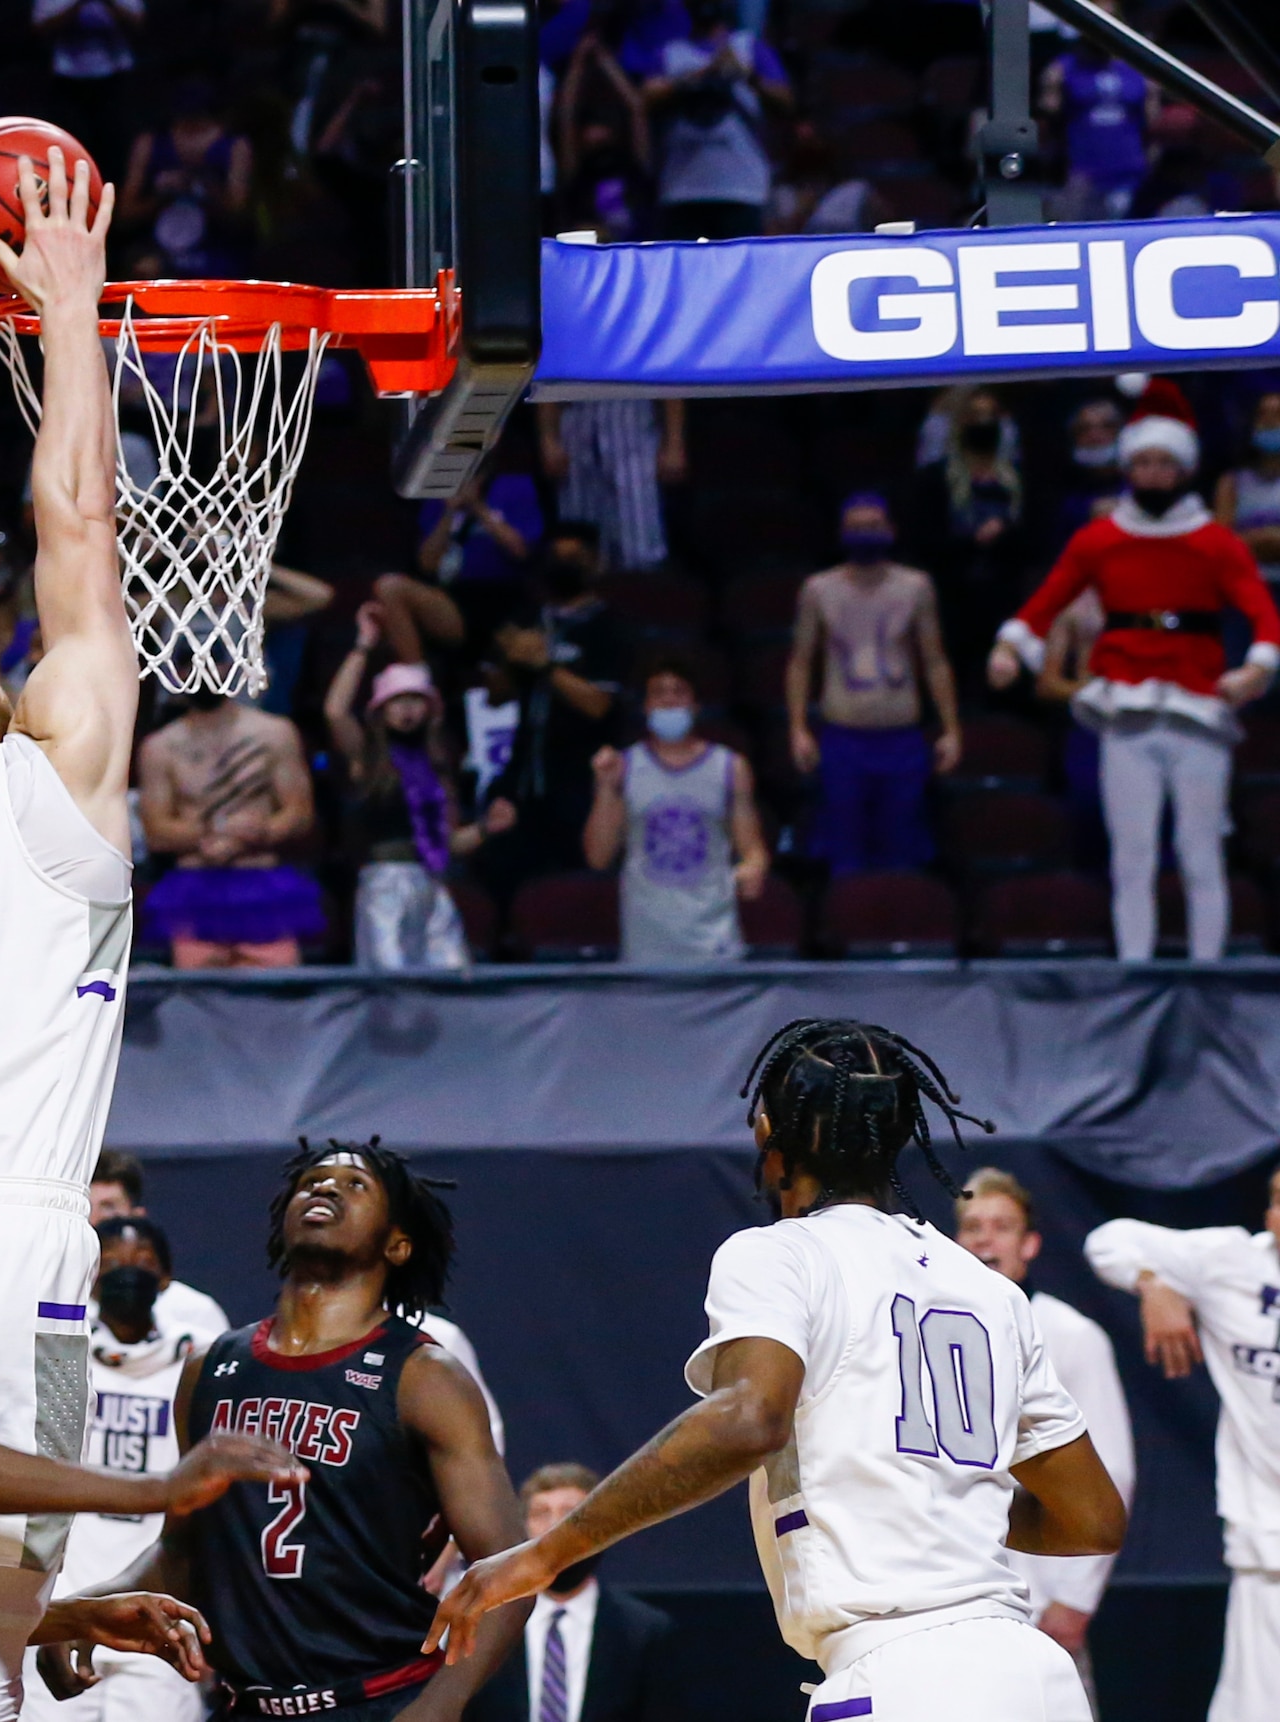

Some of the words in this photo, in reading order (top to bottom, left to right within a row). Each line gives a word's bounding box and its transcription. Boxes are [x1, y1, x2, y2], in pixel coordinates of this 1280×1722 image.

[810, 235, 1280, 362] GEIC
[345, 1368, 383, 1390] WAC
[890, 1292, 999, 1470] 10
[93, 1393, 165, 1437] JUST
[210, 1397, 361, 1468] AGGIES
[105, 1432, 146, 1472] US
[261, 1478, 307, 1580] 2
[258, 1689, 337, 1716] AGGIES
